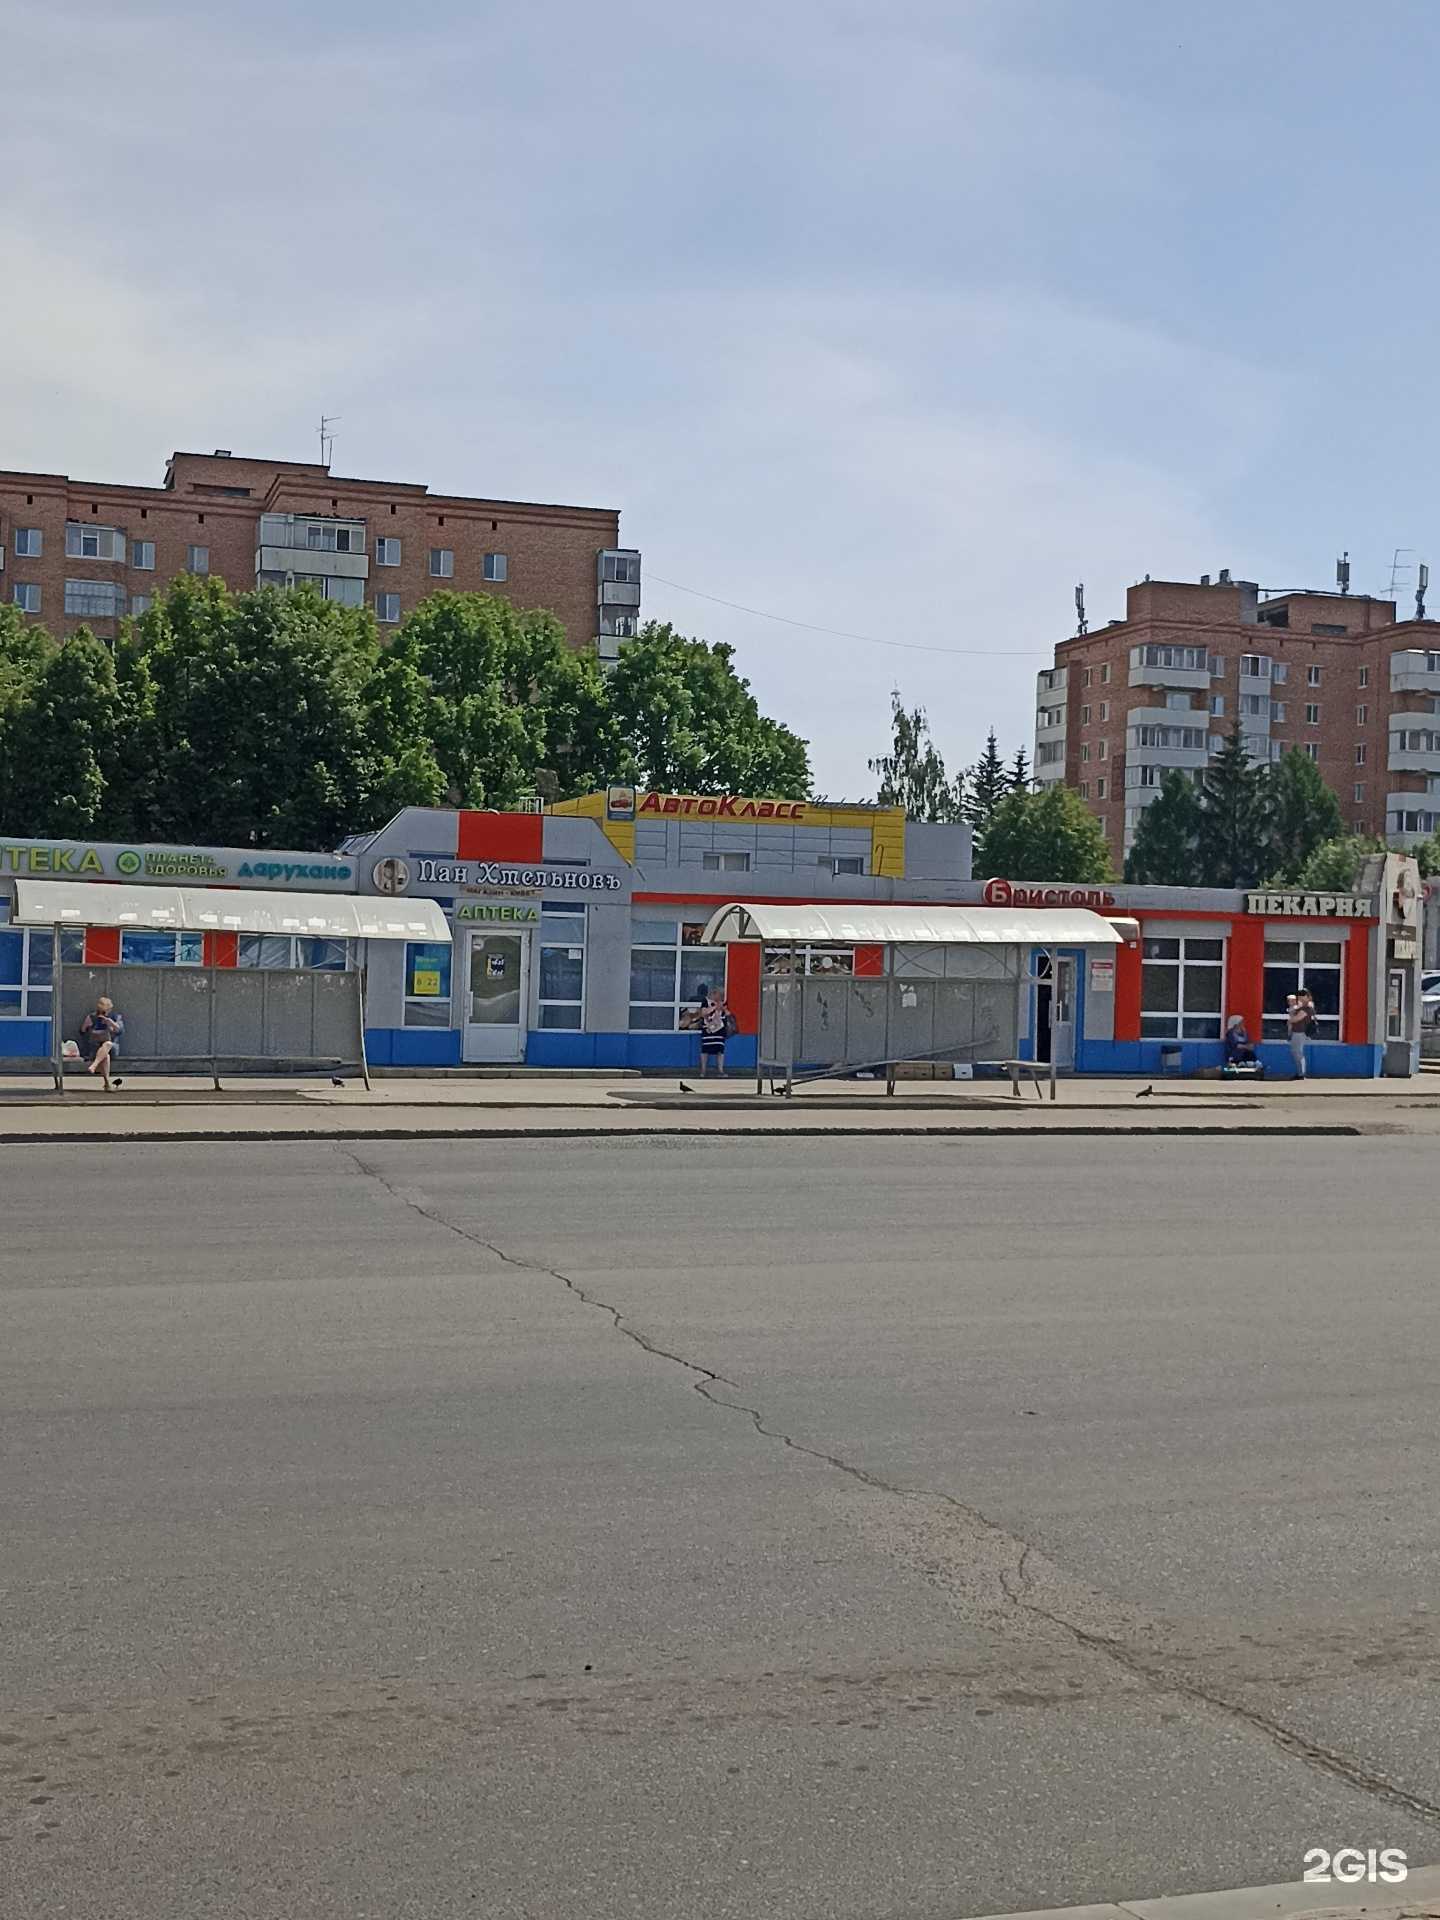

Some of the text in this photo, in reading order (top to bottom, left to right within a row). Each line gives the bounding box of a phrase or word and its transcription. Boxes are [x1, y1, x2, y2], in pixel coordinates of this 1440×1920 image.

[0, 845, 105, 874] ТЕКА
[145, 852, 216, 865] ПЛАНЕТА
[146, 864, 228, 878] ЗДОРОВЬЯ
[418, 859, 468, 883] Пан
[984, 878, 1116, 907] Бристоль
[458, 905, 538, 921] АПТЕКА
[1247, 894, 1372, 917] ПЕКАРНЯ
